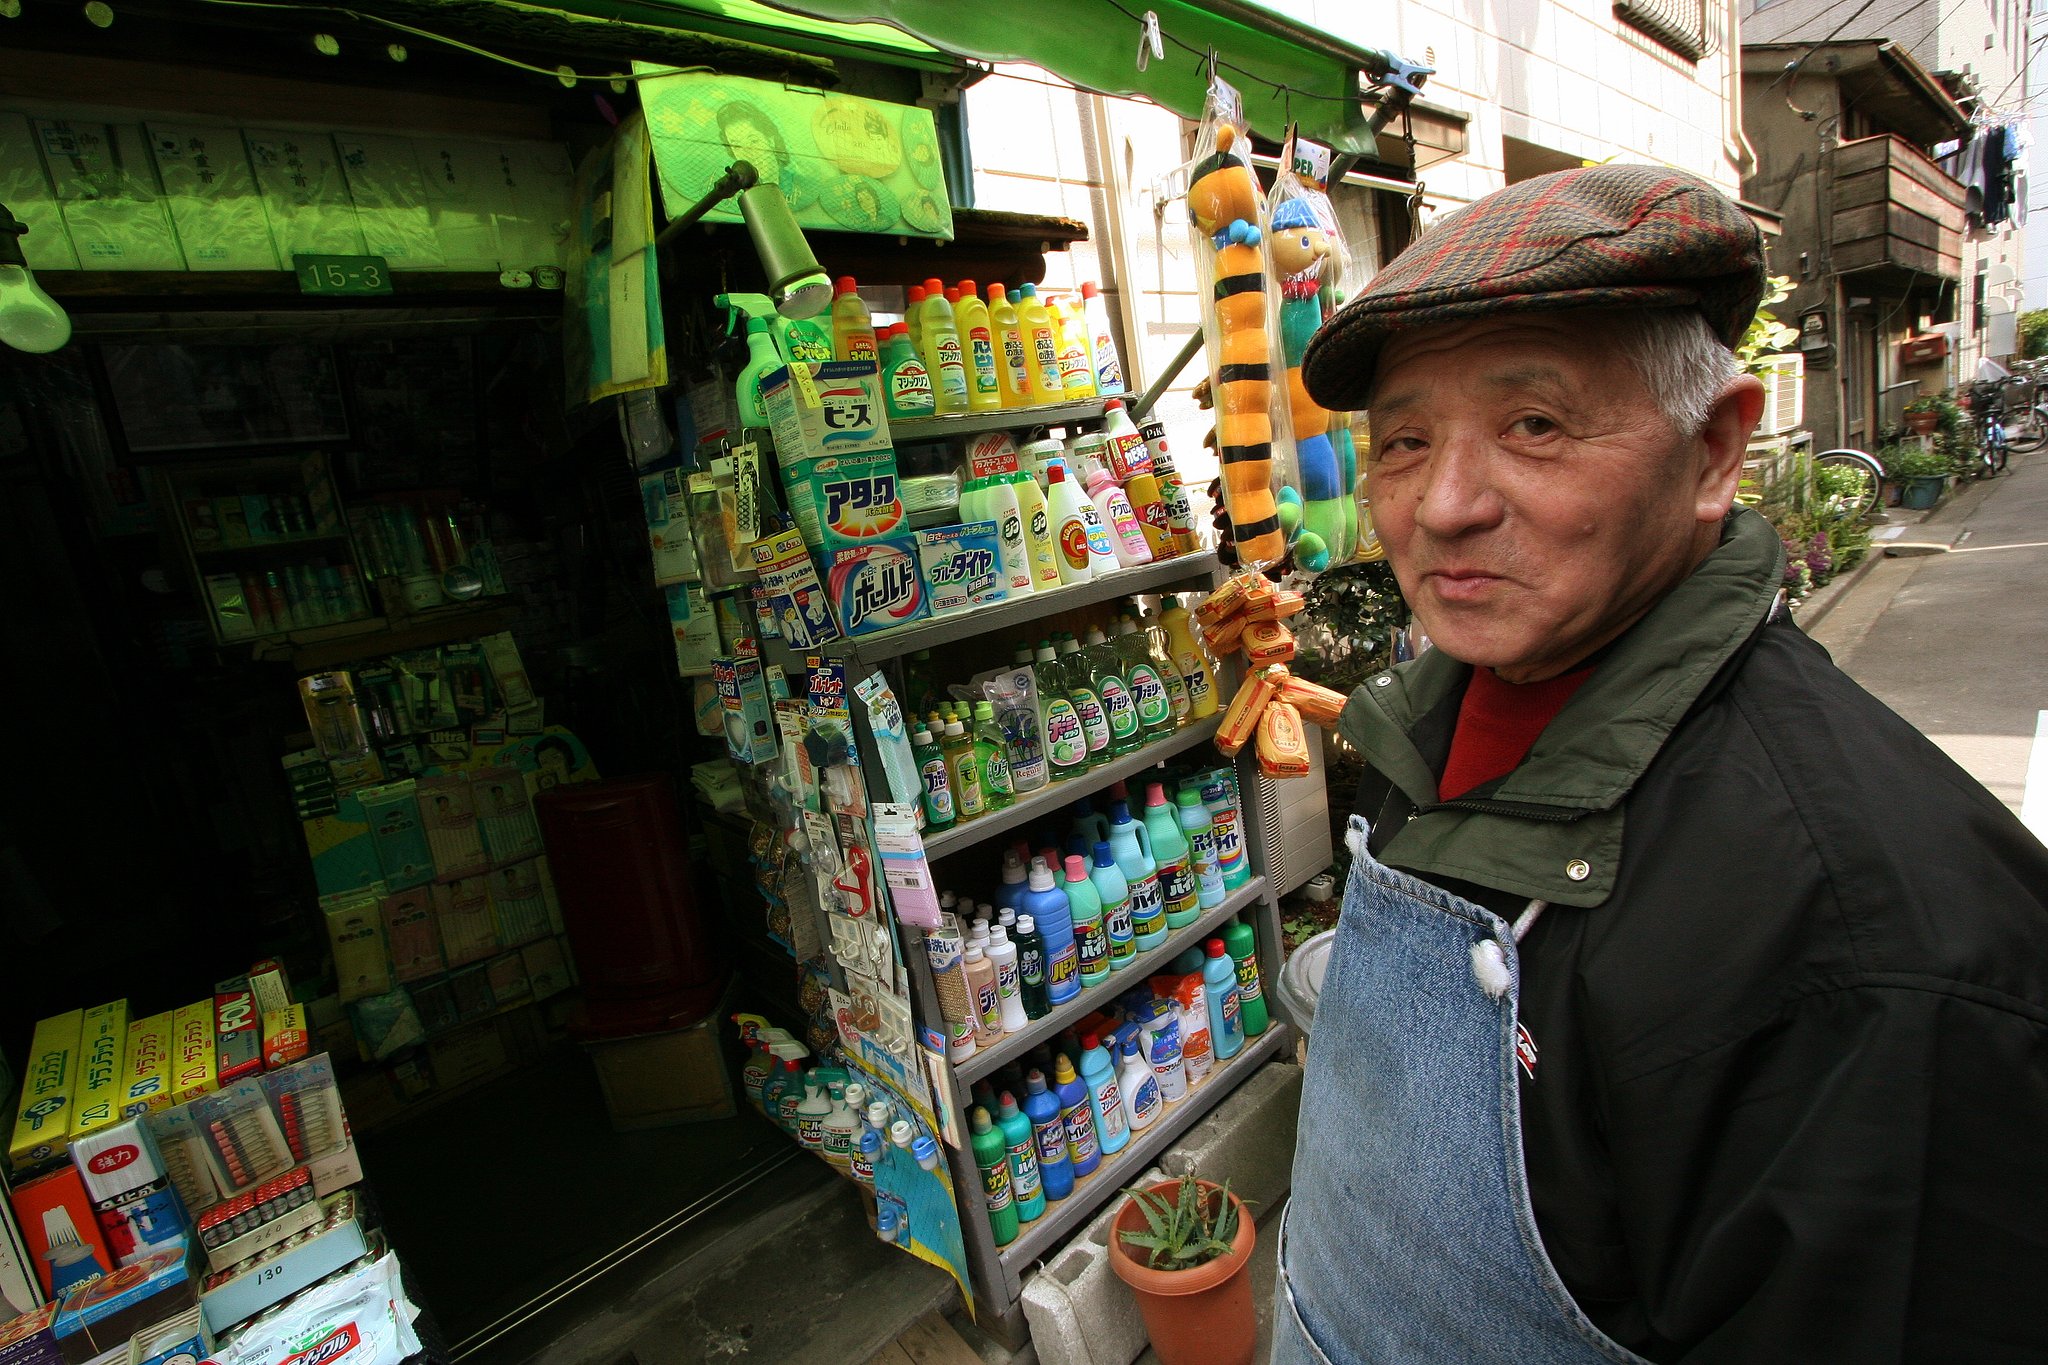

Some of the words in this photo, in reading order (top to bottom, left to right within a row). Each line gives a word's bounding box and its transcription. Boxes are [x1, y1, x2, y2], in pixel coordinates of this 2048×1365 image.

[307, 264, 382, 288] 15-3
[896, 377, 928, 390] マジックリン
[824, 404, 872, 429] ビーズ
[824, 475, 895, 525] アタック
[932, 550, 993, 584] ブルーダイヤ
[851, 558, 914, 628] ボールド
[1015, 766, 1042, 778] Regular
[184, 1020, 203, 1063] サランラップ
[88, 1036, 115, 1090] サランラップ
[129, 1075, 162, 1099] 50
[180, 1065, 208, 1086] 20
[125, 1101, 149, 1118] 50
[97, 1149, 134, 1170] 強力
[255, 1224, 283, 1244] 260
[257, 1265, 283, 1285] 130
